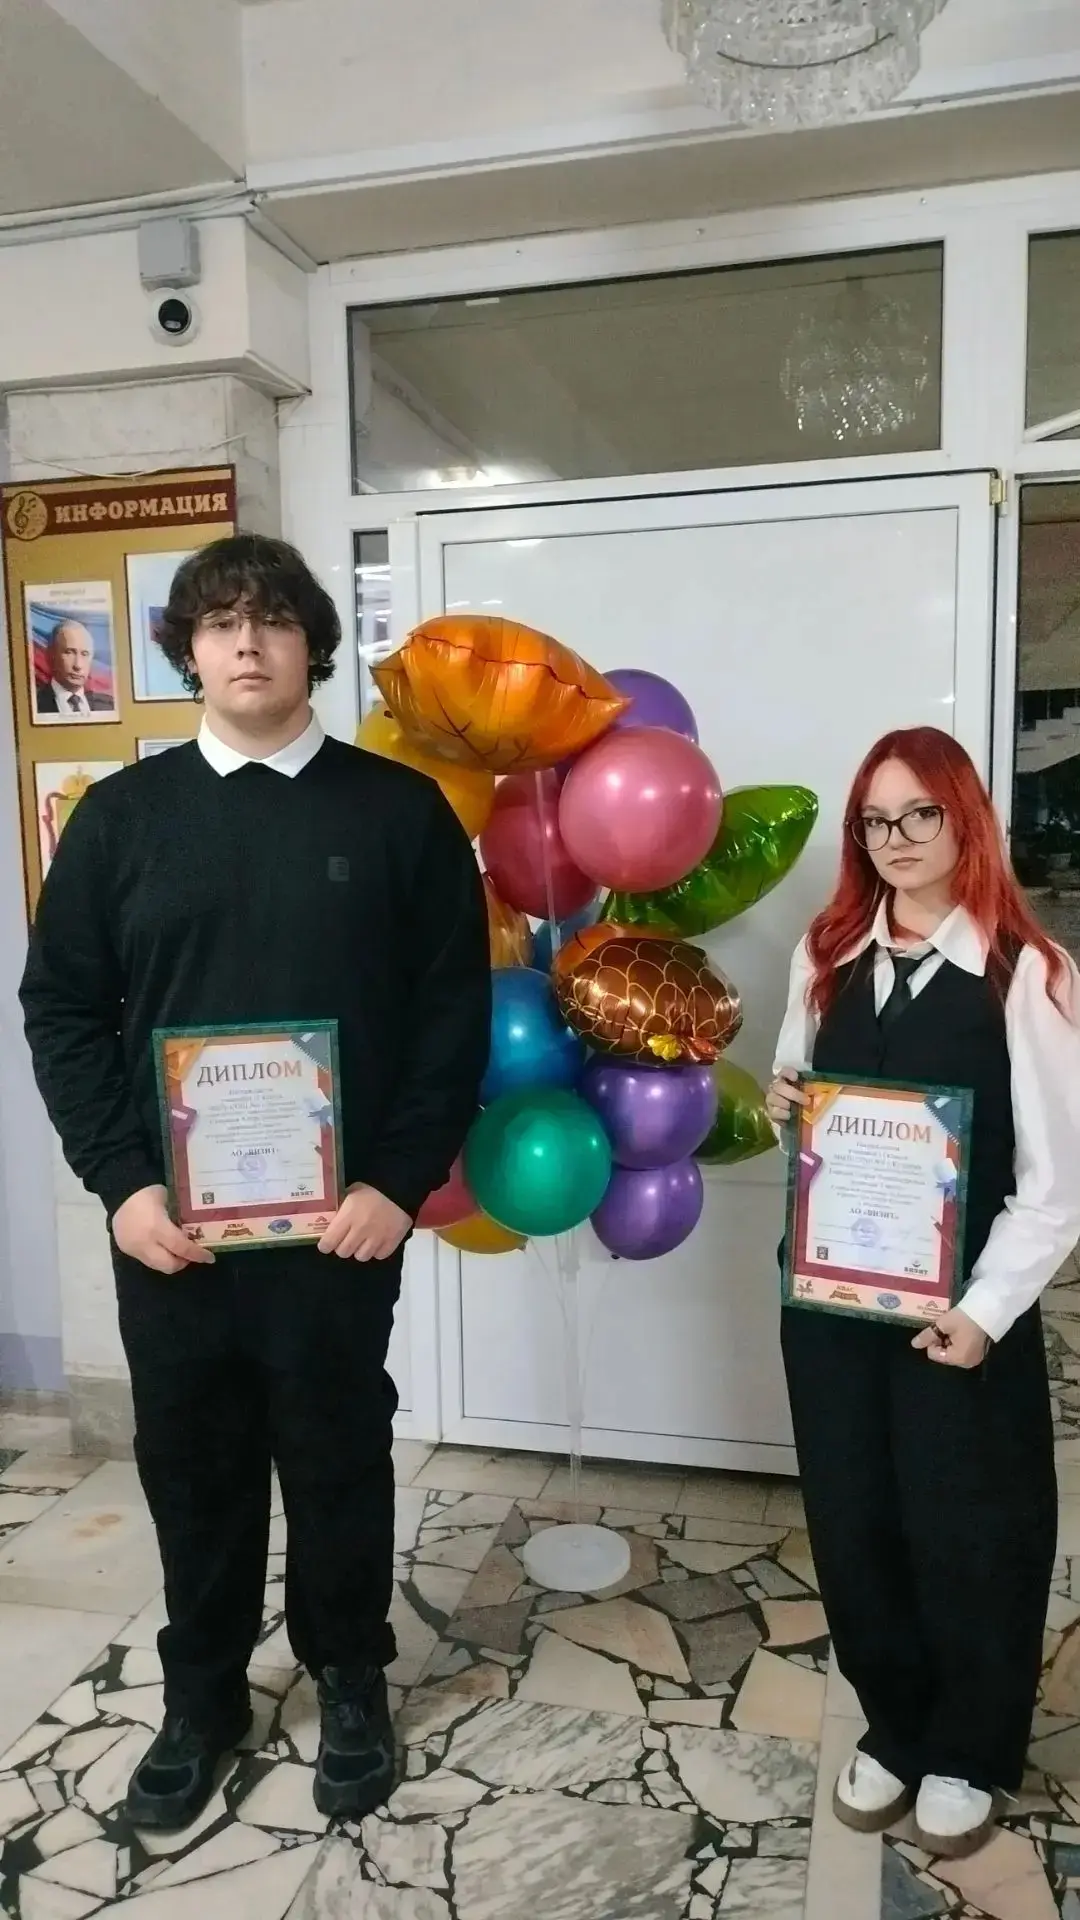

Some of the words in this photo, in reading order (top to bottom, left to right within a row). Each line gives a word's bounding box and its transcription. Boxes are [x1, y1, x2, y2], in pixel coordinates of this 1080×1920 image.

[54, 492, 228, 523] ИНФОРМАЦИЯ
[197, 1060, 302, 1087] ДИПЛОМ
[827, 1114, 932, 1143] ДИПЛОМ
